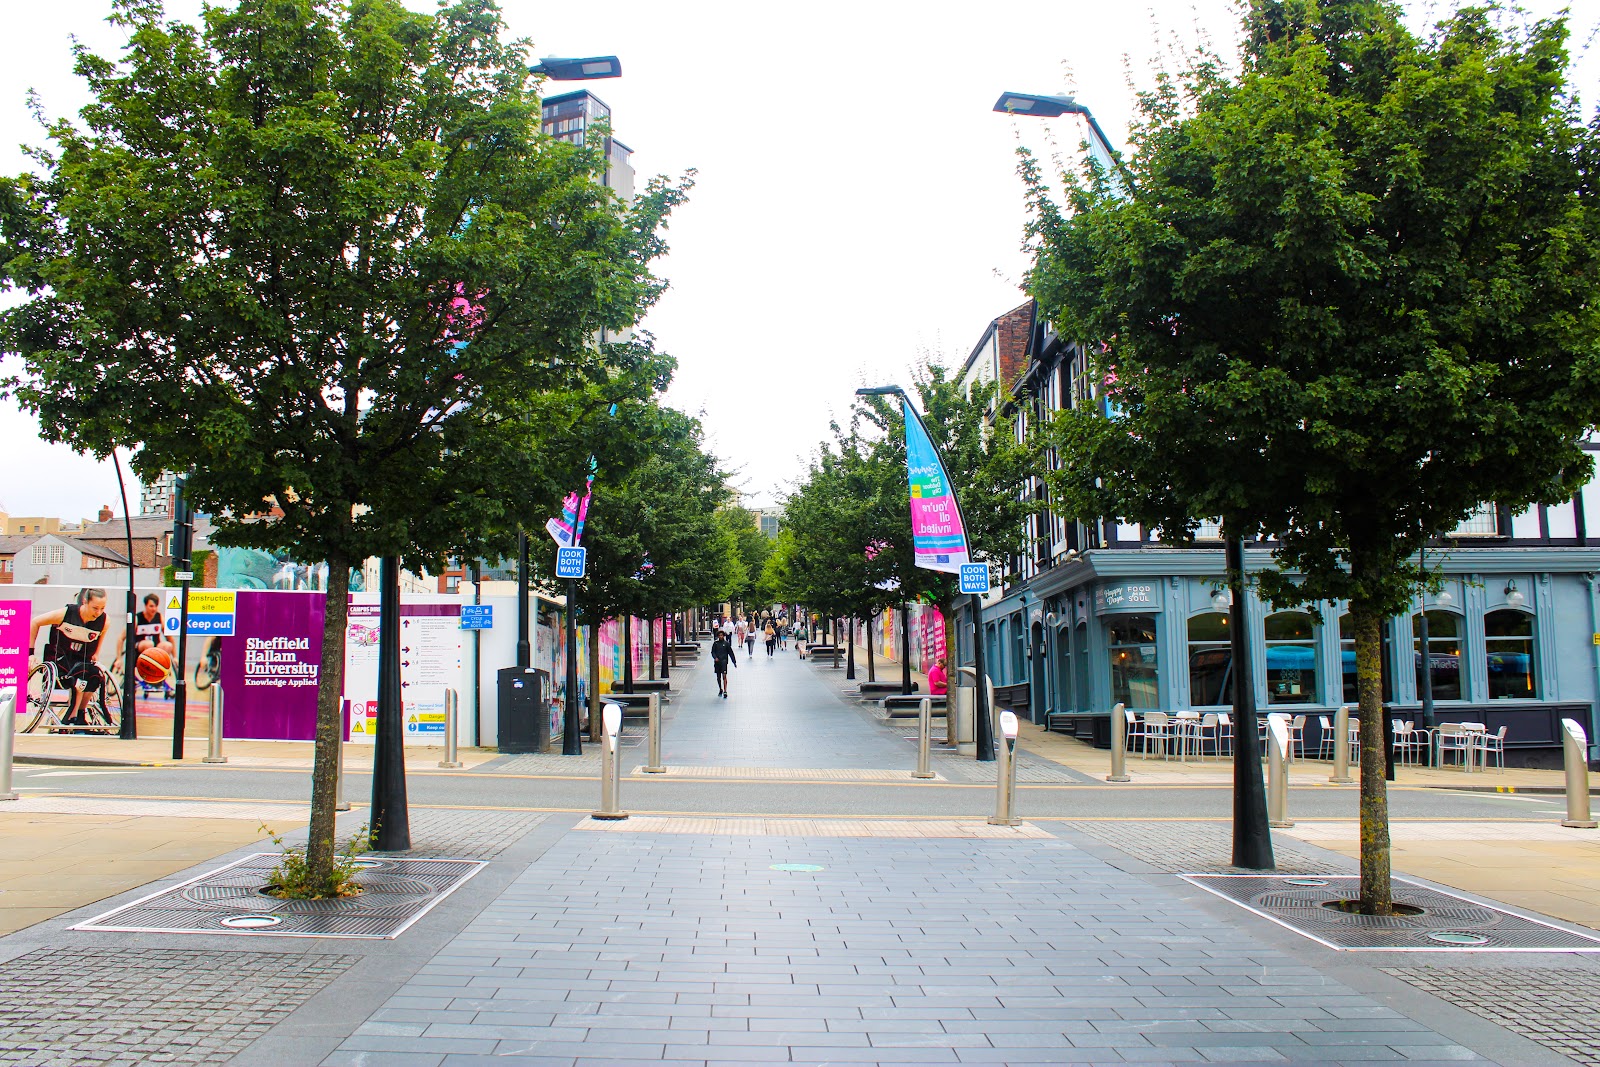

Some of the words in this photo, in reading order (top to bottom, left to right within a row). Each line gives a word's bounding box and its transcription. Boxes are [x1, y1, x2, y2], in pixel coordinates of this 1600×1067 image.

[561, 550, 582, 558] LOOK
[560, 558, 581, 566] BOTH
[560, 565, 581, 574] WAYS
[963, 566, 985, 574] LOOK
[963, 574, 986, 582] BOTH
[964, 582, 986, 590] WAYS
[1104, 588, 1123, 598] Happy
[9, 608, 16, 616] to
[186, 619, 211, 630] Keep
[213, 620, 231, 628] out
[246, 636, 310, 650] Sheffield
[245, 650, 297, 662] Hallam
[245, 661, 319, 678] University
[5, 676, 17, 684] and
[244, 678, 287, 688] Knowledge
[288, 678, 318, 688] Applied
